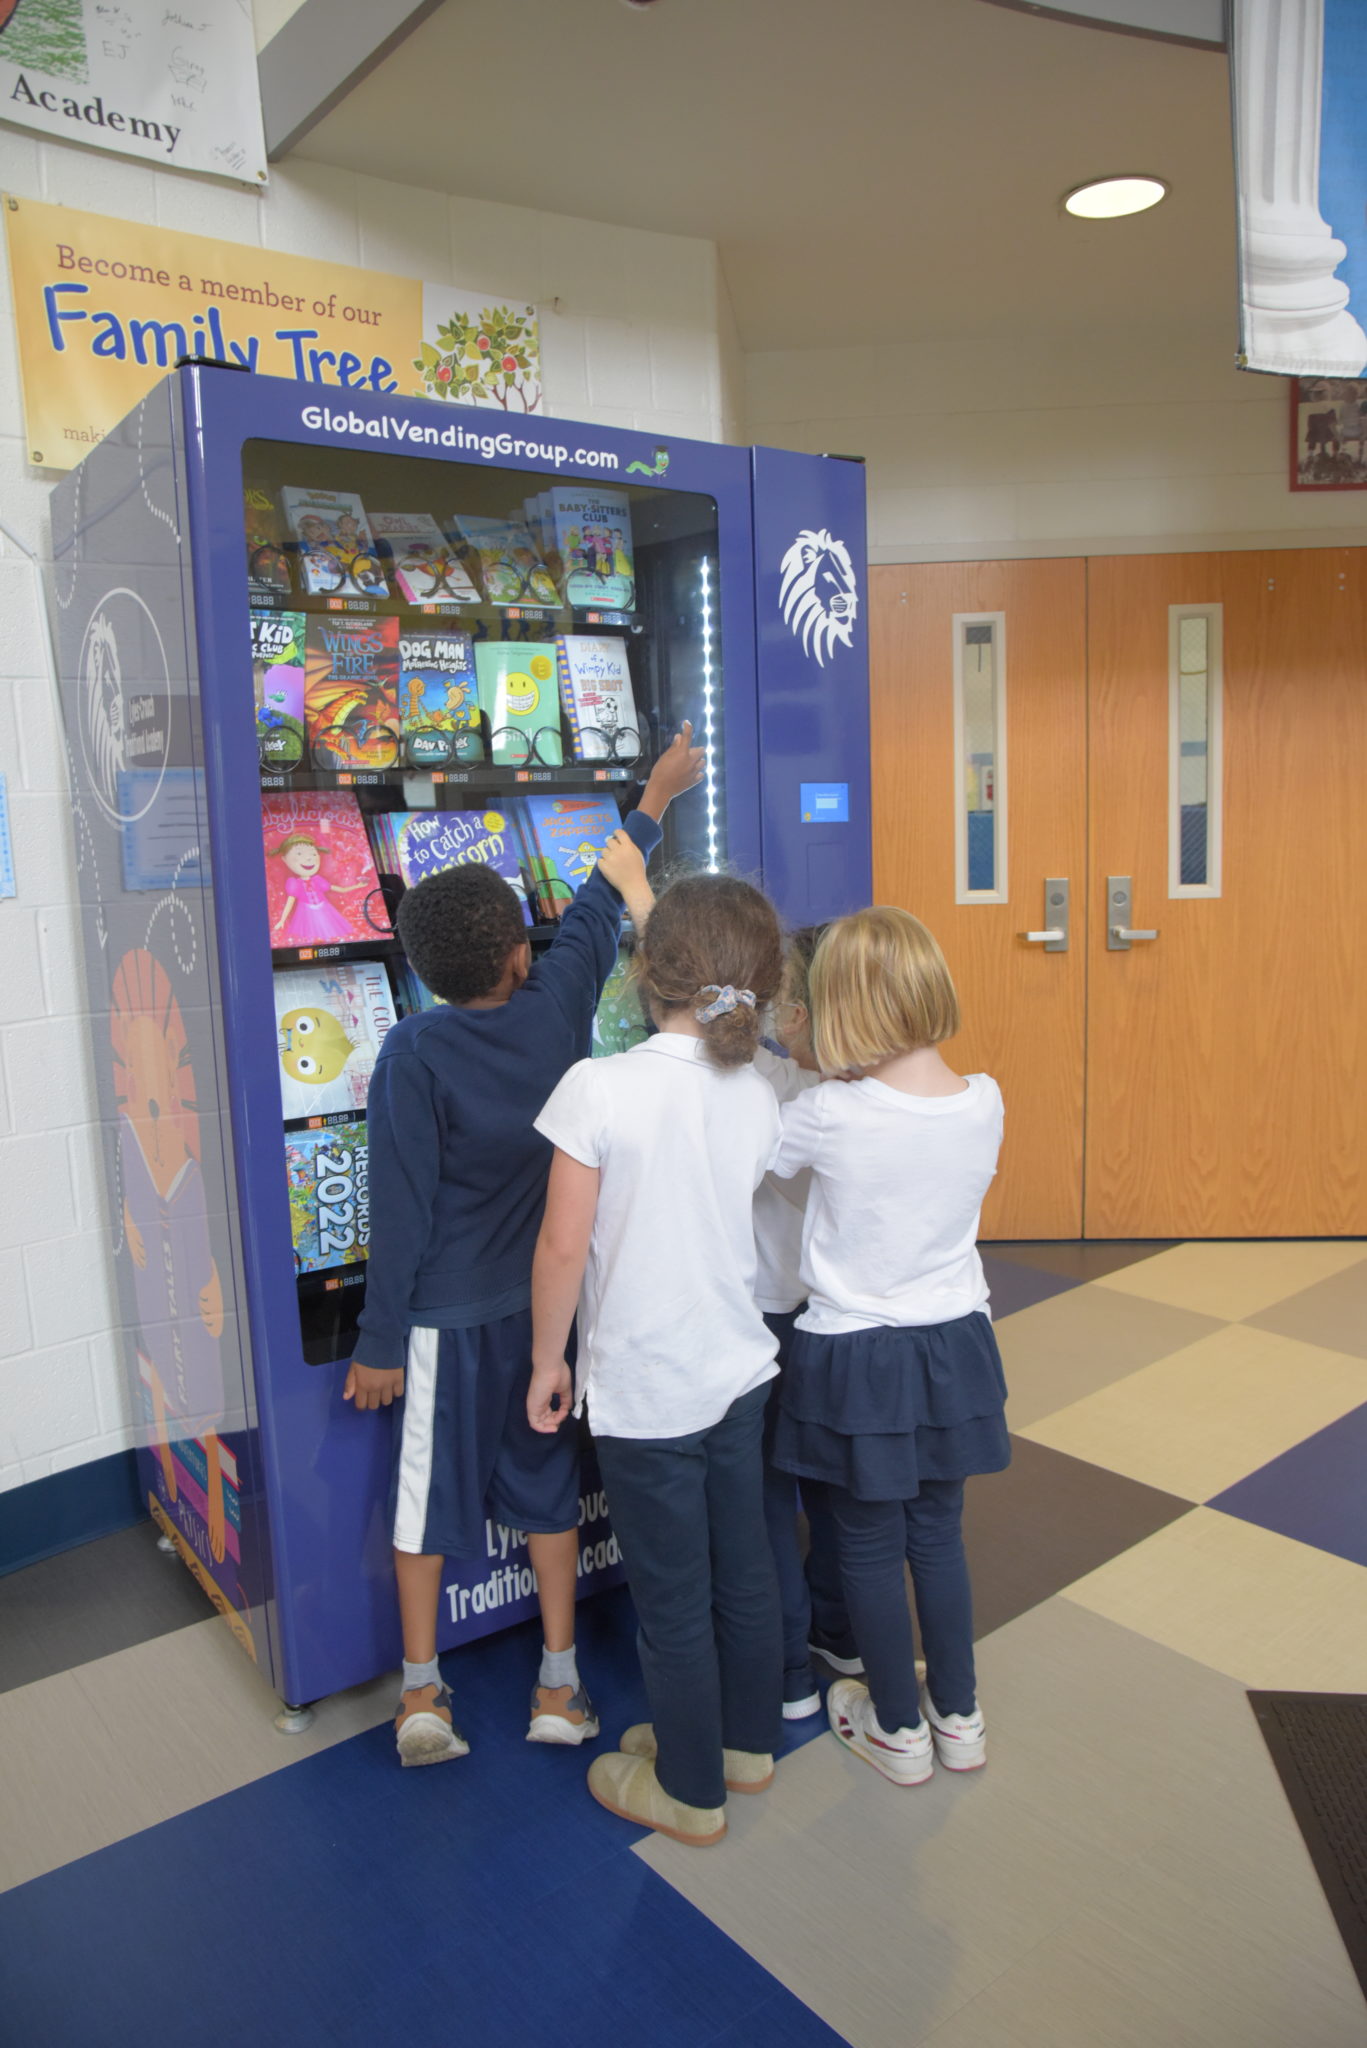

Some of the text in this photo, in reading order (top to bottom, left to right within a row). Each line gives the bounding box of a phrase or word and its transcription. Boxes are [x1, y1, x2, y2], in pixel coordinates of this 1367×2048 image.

[10, 73, 182, 153] Academy
[56, 244, 382, 327] Become a member of our
[44, 283, 398, 395] Family Tree
[63, 425, 106, 444] maki
[301, 406, 619, 468] GlobalVendingGroup.com
[558, 503, 628, 518] BABY-SITTERS
[582, 513, 608, 523] CLUB
[317, 627, 384, 654] WINGS
[399, 640, 465, 660] DOG MAN
[332, 653, 376, 674] FIRE
[574, 662, 622, 678] Wimpy Kid
[580, 679, 597, 692] BIG
[407, 815, 440, 842] How
[414, 848, 430, 864] to
[430, 817, 475, 859] Catch
[474, 816, 483, 830] a
[365, 973, 385, 1001] THE
[316, 1150, 356, 1256] 2022
[354, 1145, 371, 1246] RECORDS
[485, 1519, 528, 1560] Lyle
